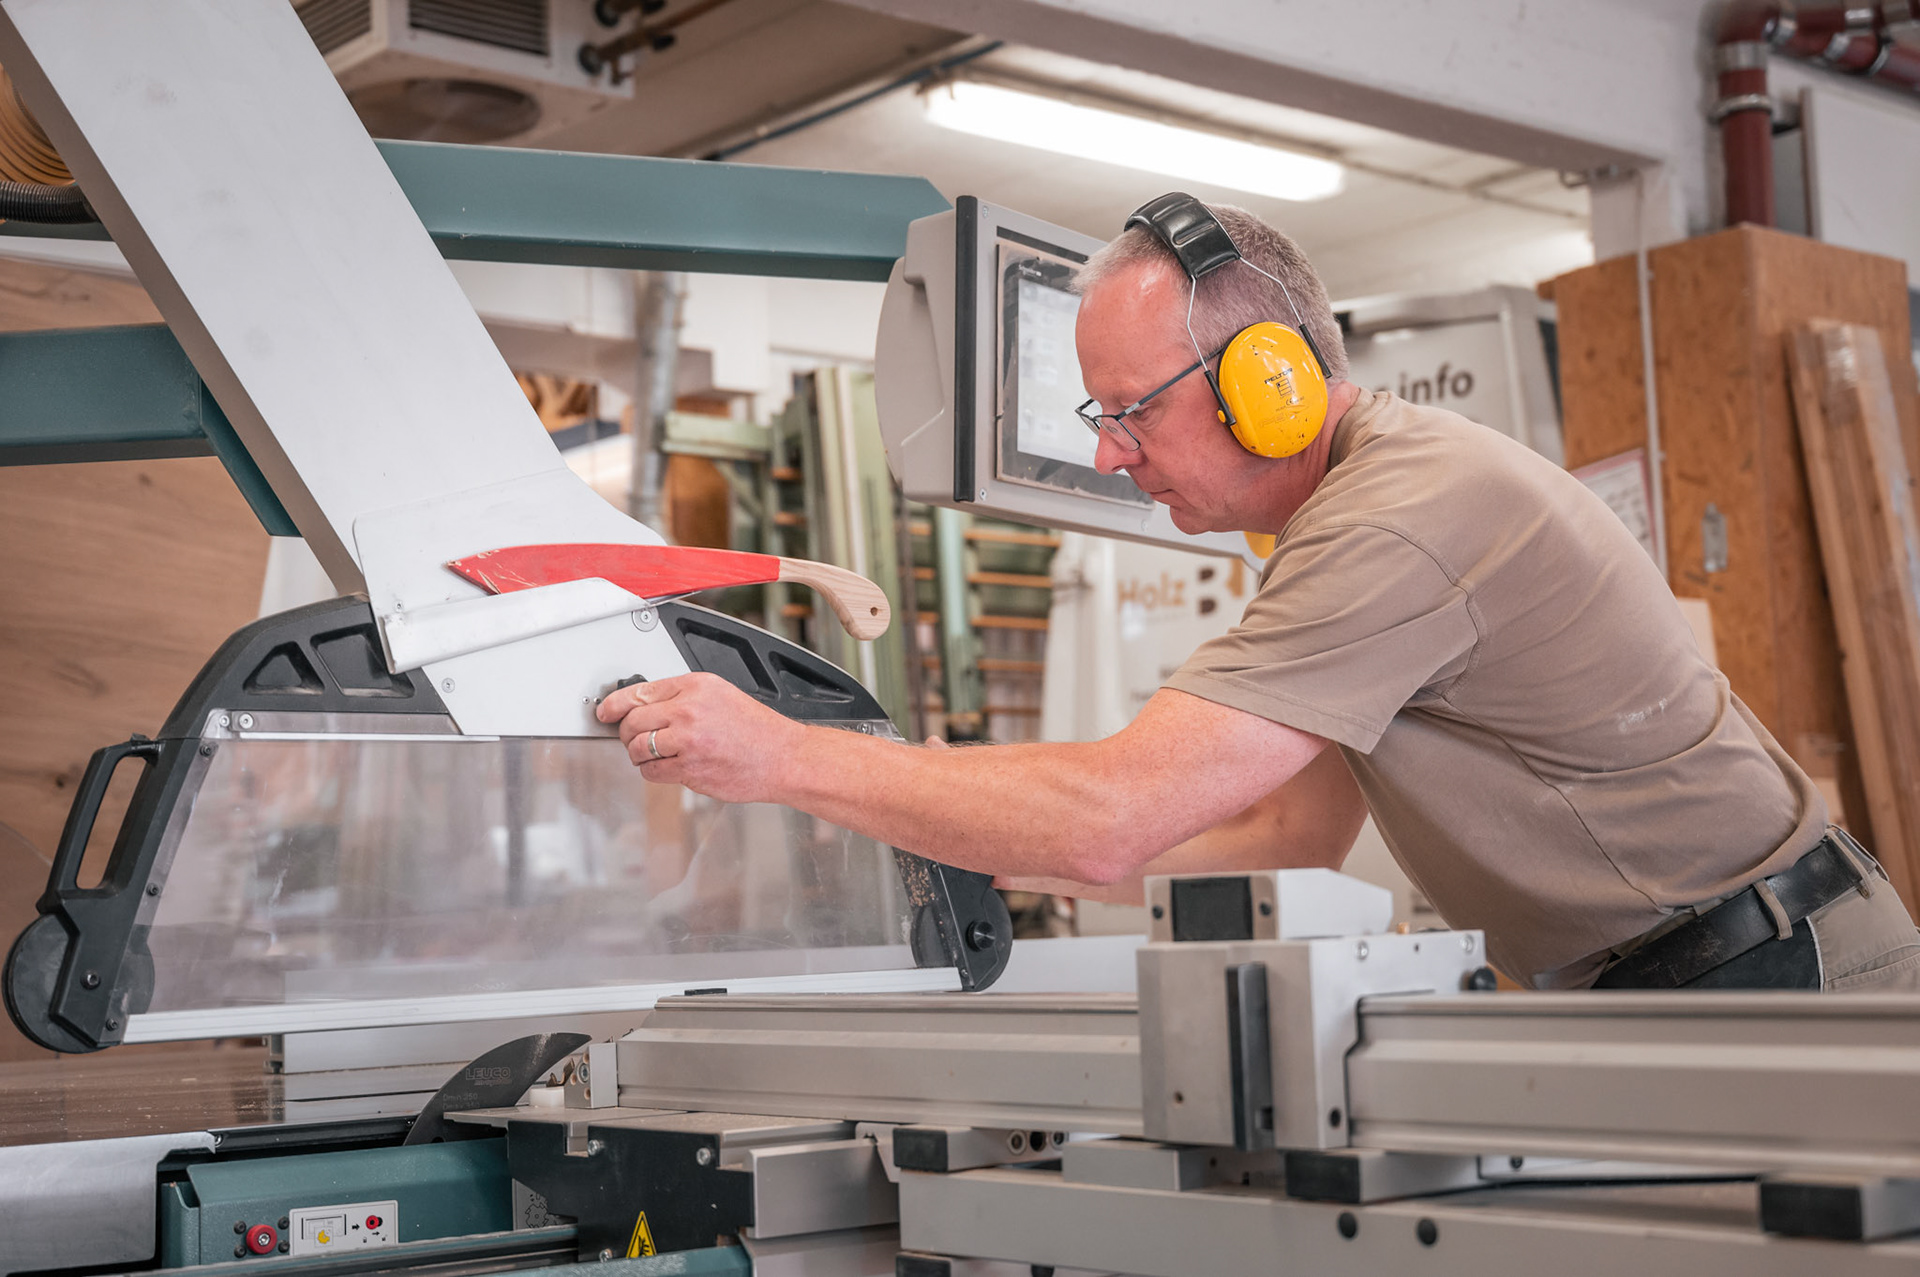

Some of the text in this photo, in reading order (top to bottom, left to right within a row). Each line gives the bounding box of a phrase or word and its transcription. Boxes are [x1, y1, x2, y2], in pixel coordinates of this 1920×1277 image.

[1264, 367, 1293, 384] PELTOR
[1373, 361, 1475, 403] info
[1117, 571, 1187, 614] Holz
[465, 1066, 511, 1080] LEUCO
